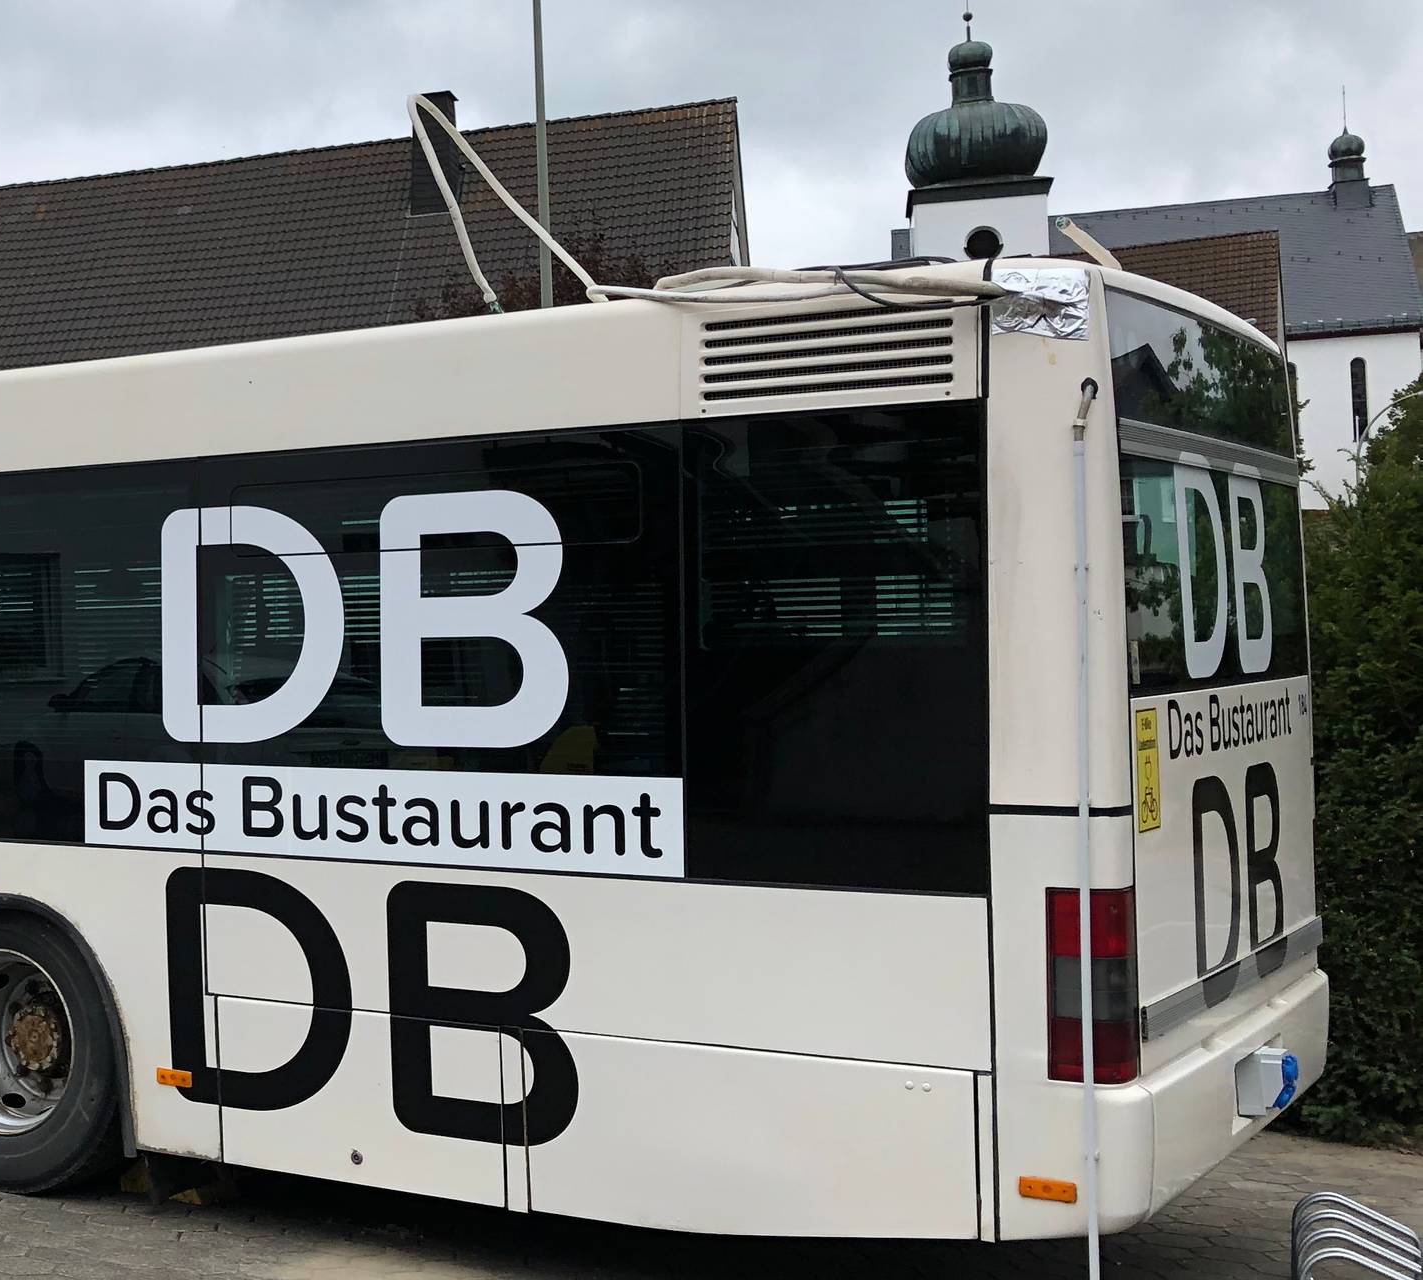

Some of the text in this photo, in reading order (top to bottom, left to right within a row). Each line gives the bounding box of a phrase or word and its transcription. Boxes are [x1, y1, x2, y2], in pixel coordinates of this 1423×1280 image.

[161, 490, 569, 748] DB
[1174, 451, 1273, 679] DB
[98, 771, 663, 859] Das Bustaurant
[1167, 687, 1292, 760] Das Bustaurant
[1192, 761, 1288, 1009] DB
[165, 866, 579, 1146] DB
